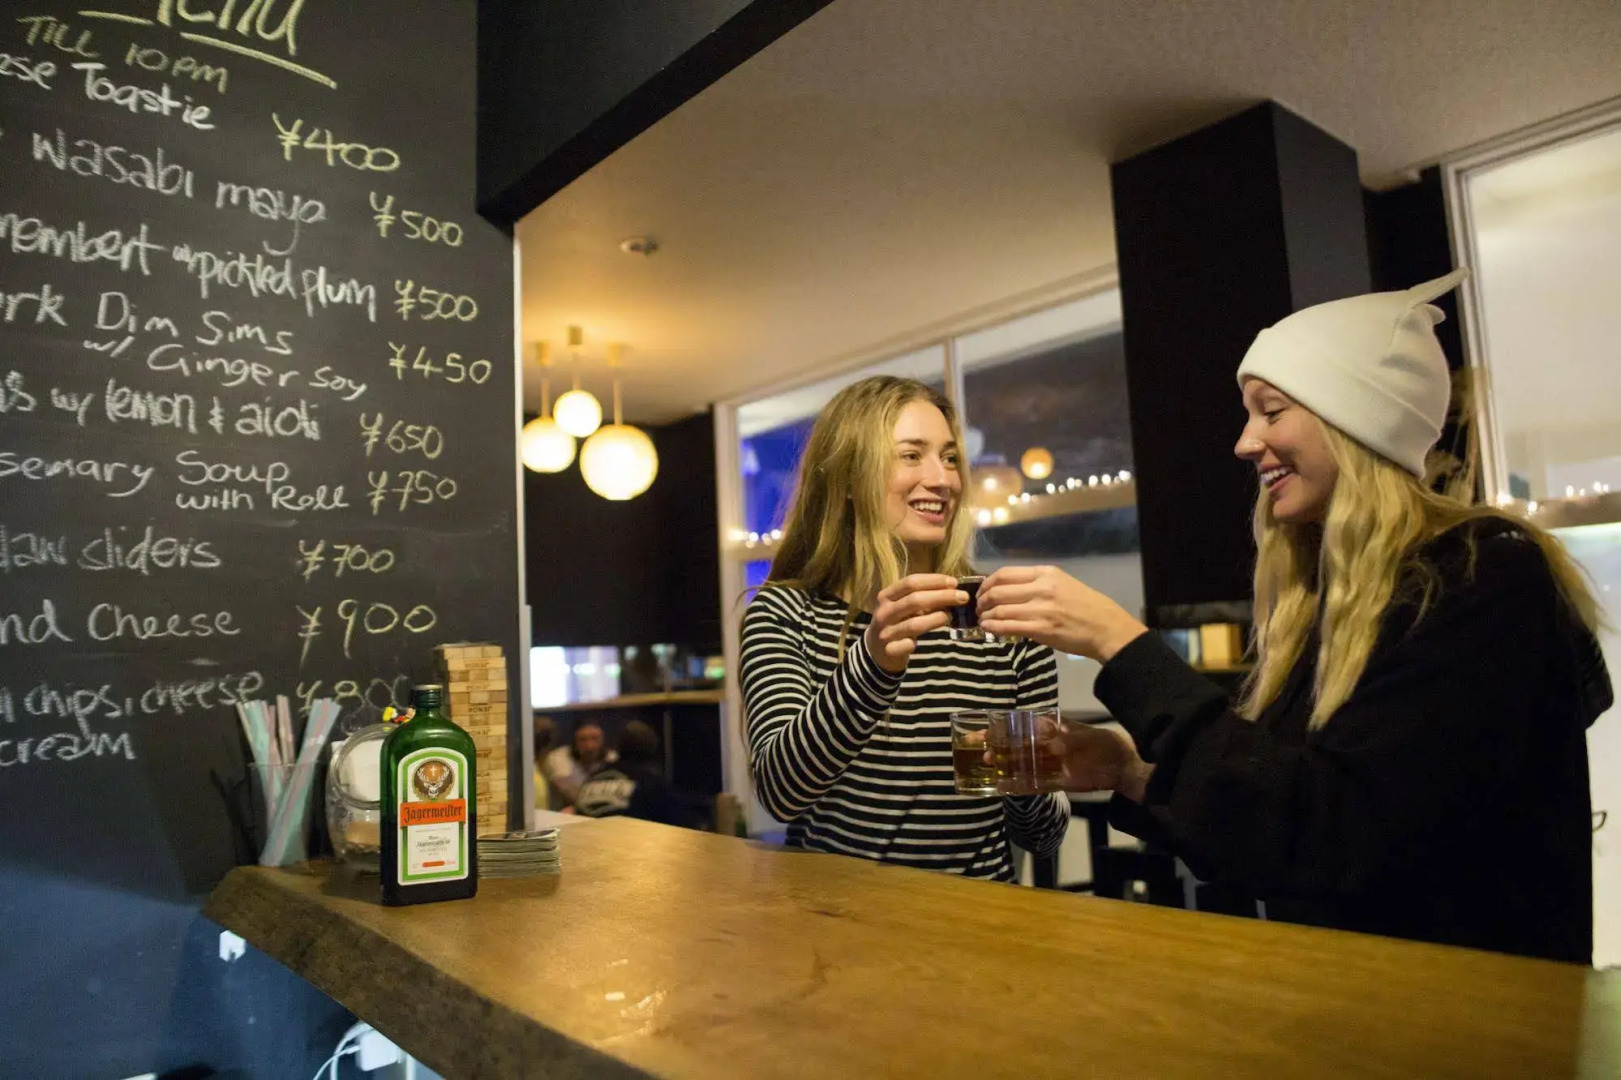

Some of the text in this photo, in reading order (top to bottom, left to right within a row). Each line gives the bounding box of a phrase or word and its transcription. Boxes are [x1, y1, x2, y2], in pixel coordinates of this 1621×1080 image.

[71, 62, 216, 130] Toastie
[272, 112, 401, 172] ¥400
[32, 127, 464, 256] Wasabi mayo ¥500
[301, 265, 377, 323] plum
[394, 278, 479, 323] ¥500
[95, 291, 180, 338] Dim
[196, 310, 294, 356] Sims
[388, 341, 492, 384] ¥450
[147, 343, 300, 388] Ginger
[105, 376, 199, 434] lemon
[360, 412, 445, 460] ¥650
[175, 450, 292, 495] Soup
[367, 470, 459, 516] ¥750
[175, 488, 254, 511] with
[298, 539, 396, 581] ¥700
[296, 599, 438, 663] ¥900
[139, 670, 264, 716] cheese
